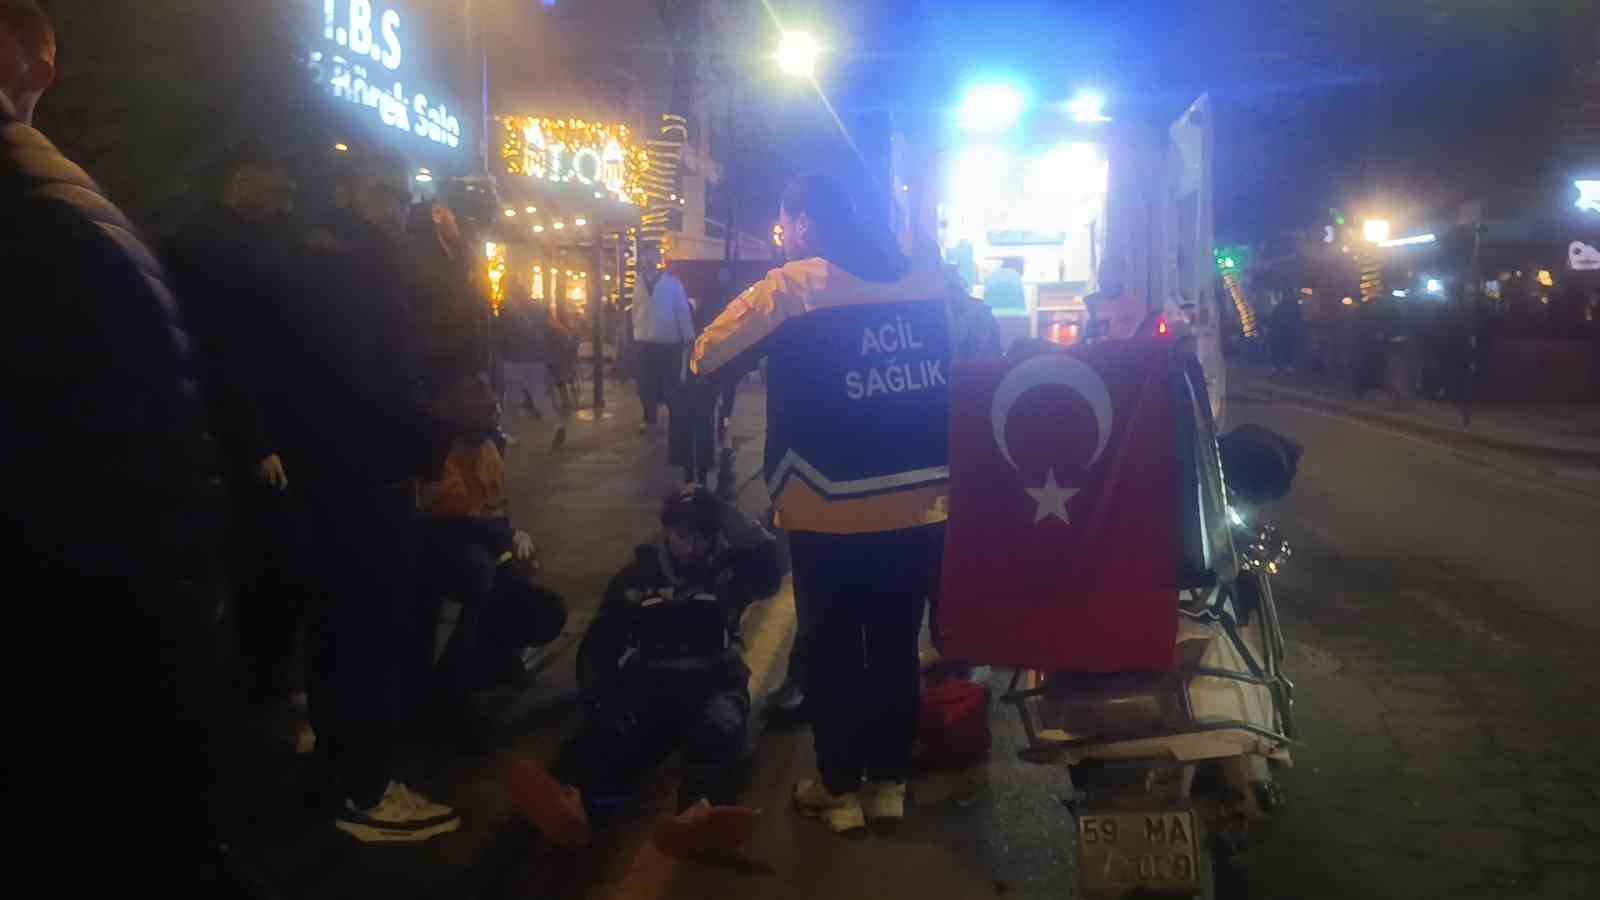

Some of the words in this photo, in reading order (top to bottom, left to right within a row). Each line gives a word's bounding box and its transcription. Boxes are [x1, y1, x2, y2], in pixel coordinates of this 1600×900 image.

[861, 315, 924, 356] ACİL
[845, 358, 947, 401] SAĞLIK
[1082, 817, 1118, 845] 59
[1144, 815, 1190, 845] MA
